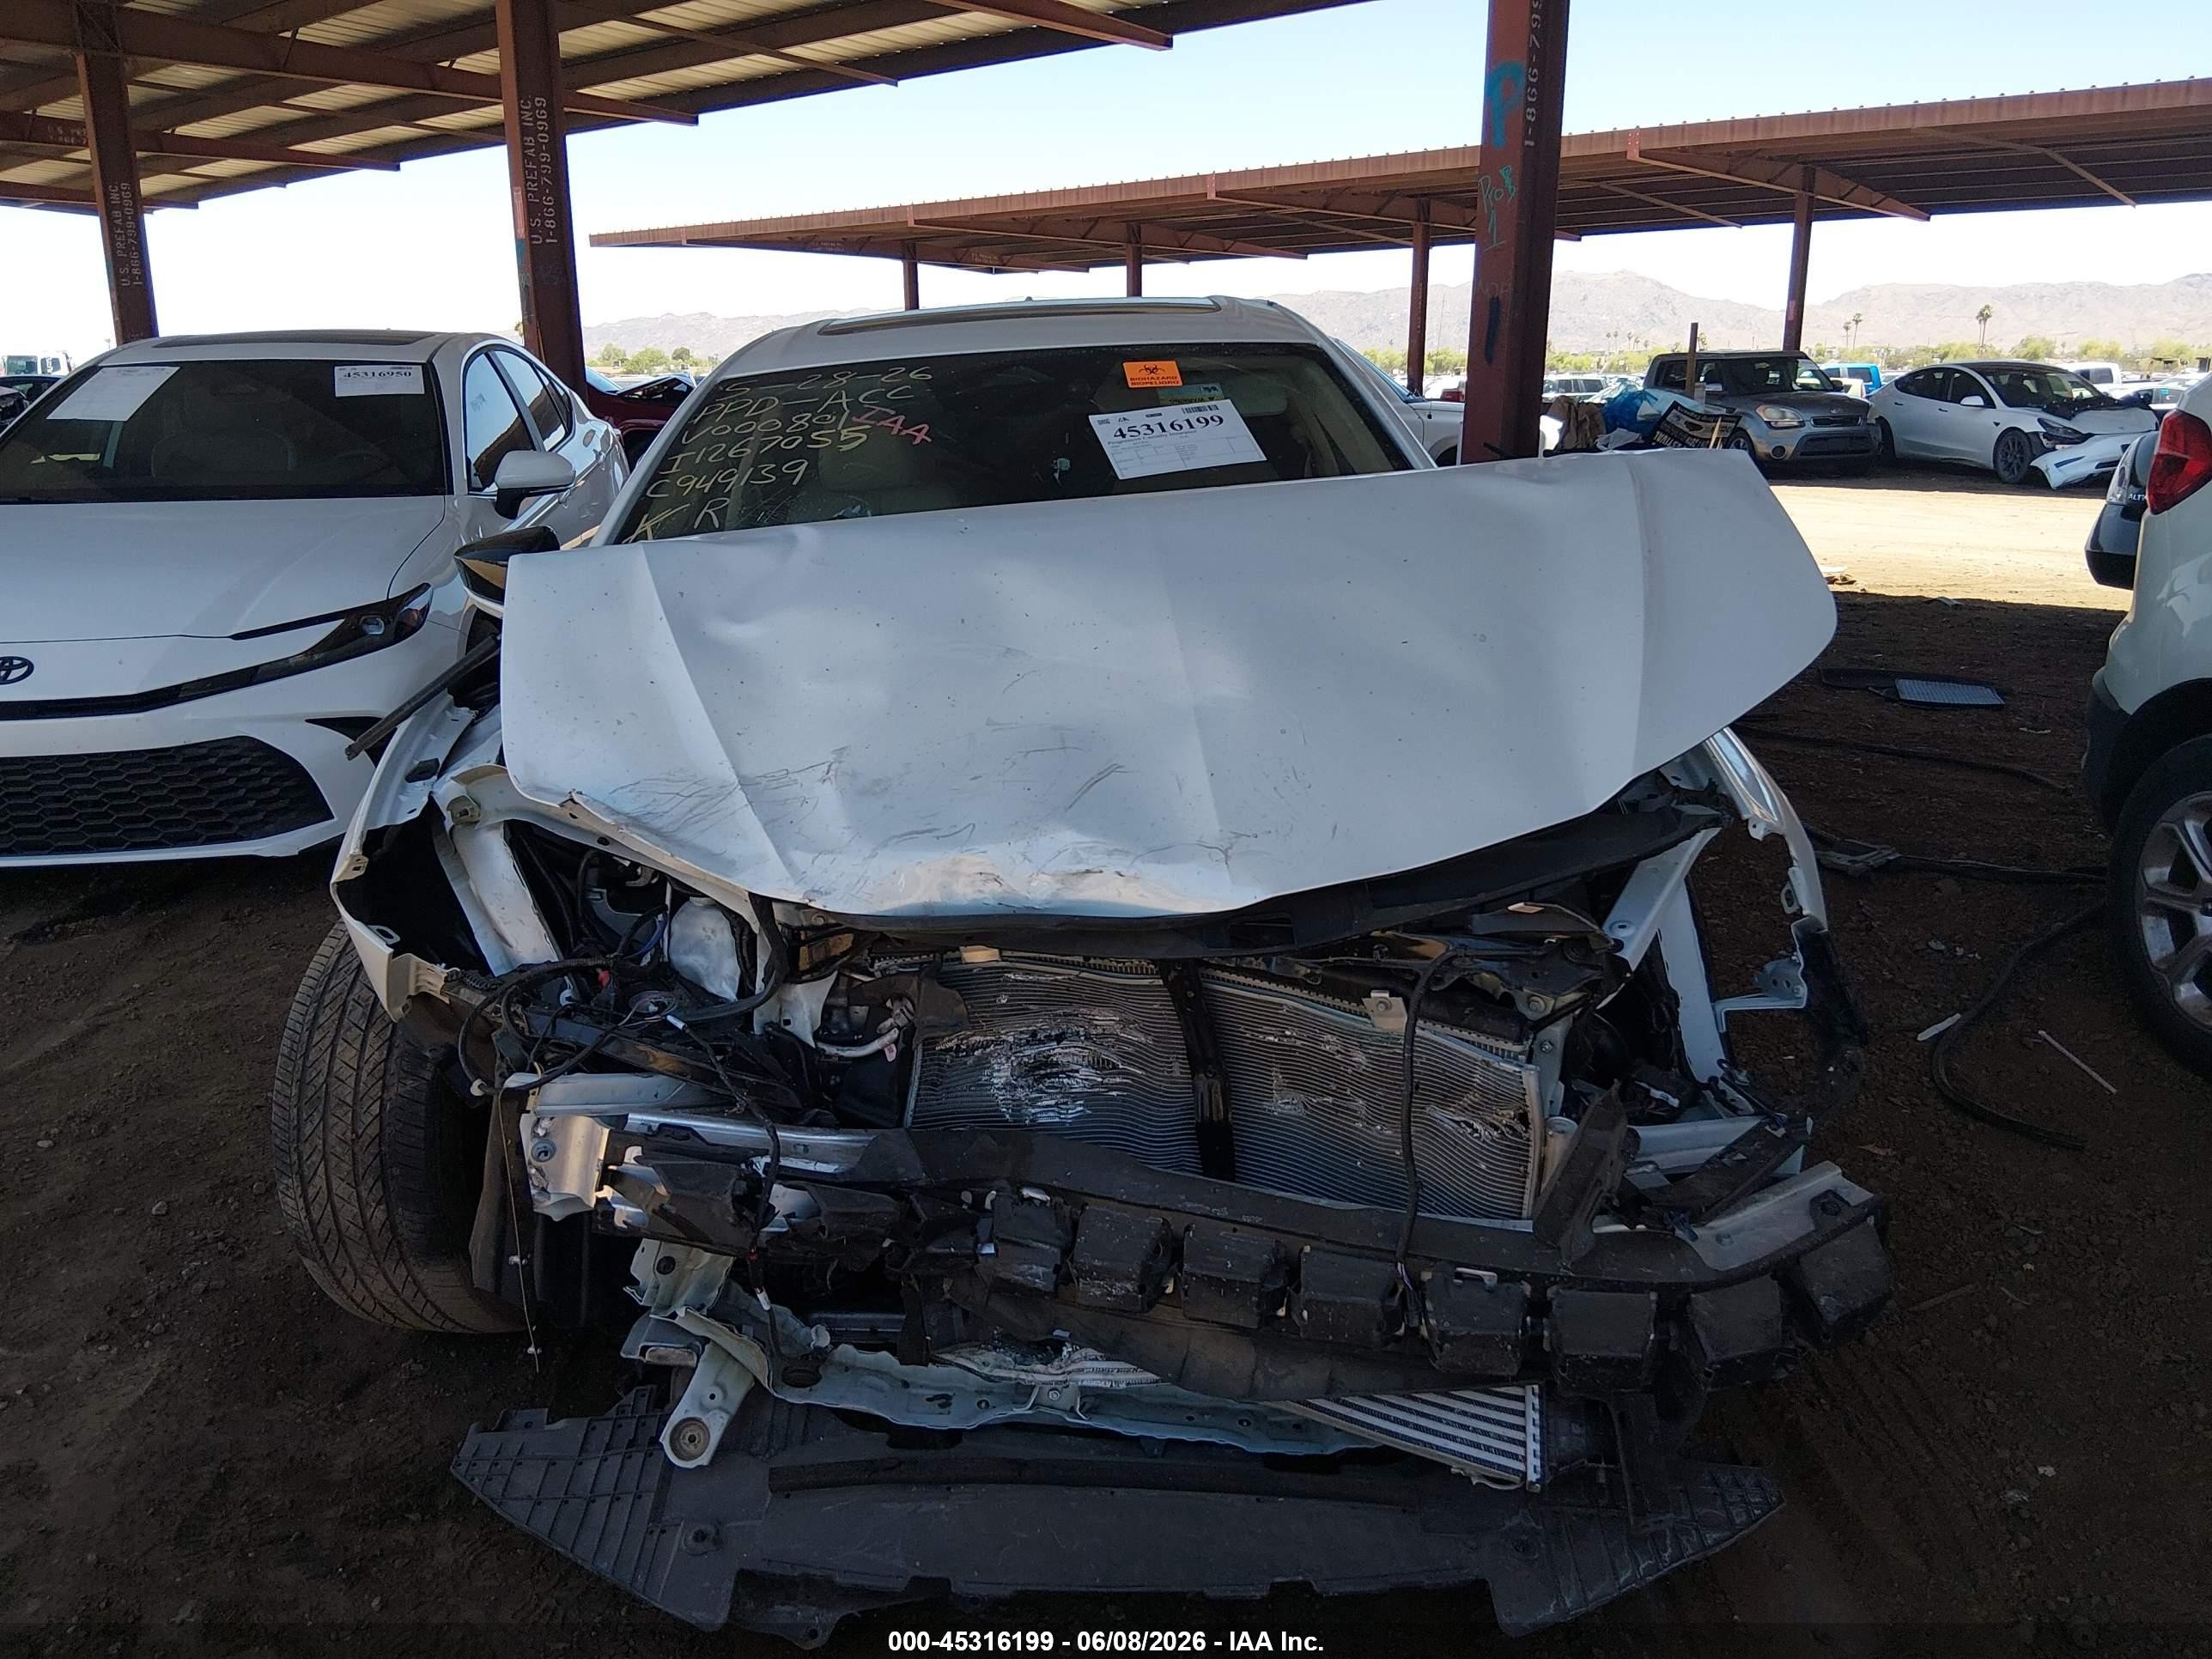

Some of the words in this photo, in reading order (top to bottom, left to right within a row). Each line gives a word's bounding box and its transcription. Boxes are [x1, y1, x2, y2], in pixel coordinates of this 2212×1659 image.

[520, 94, 535, 127] INC.
[523, 137, 540, 203] PREFAB
[534, 96, 558, 244] 1-866-799-0969
[108, 181, 121, 204] INC.
[112, 210, 128, 257] PREFAB
[120, 182, 143, 286] 1-866-799-0969
[530, 212, 543, 245] U.S.
[119, 263, 131, 287] U.S.
[851, 404, 933, 446] IAA
[1113, 414, 1224, 439] 45316199
[646, 459, 810, 498] C949139
[694, 497, 731, 530] R
